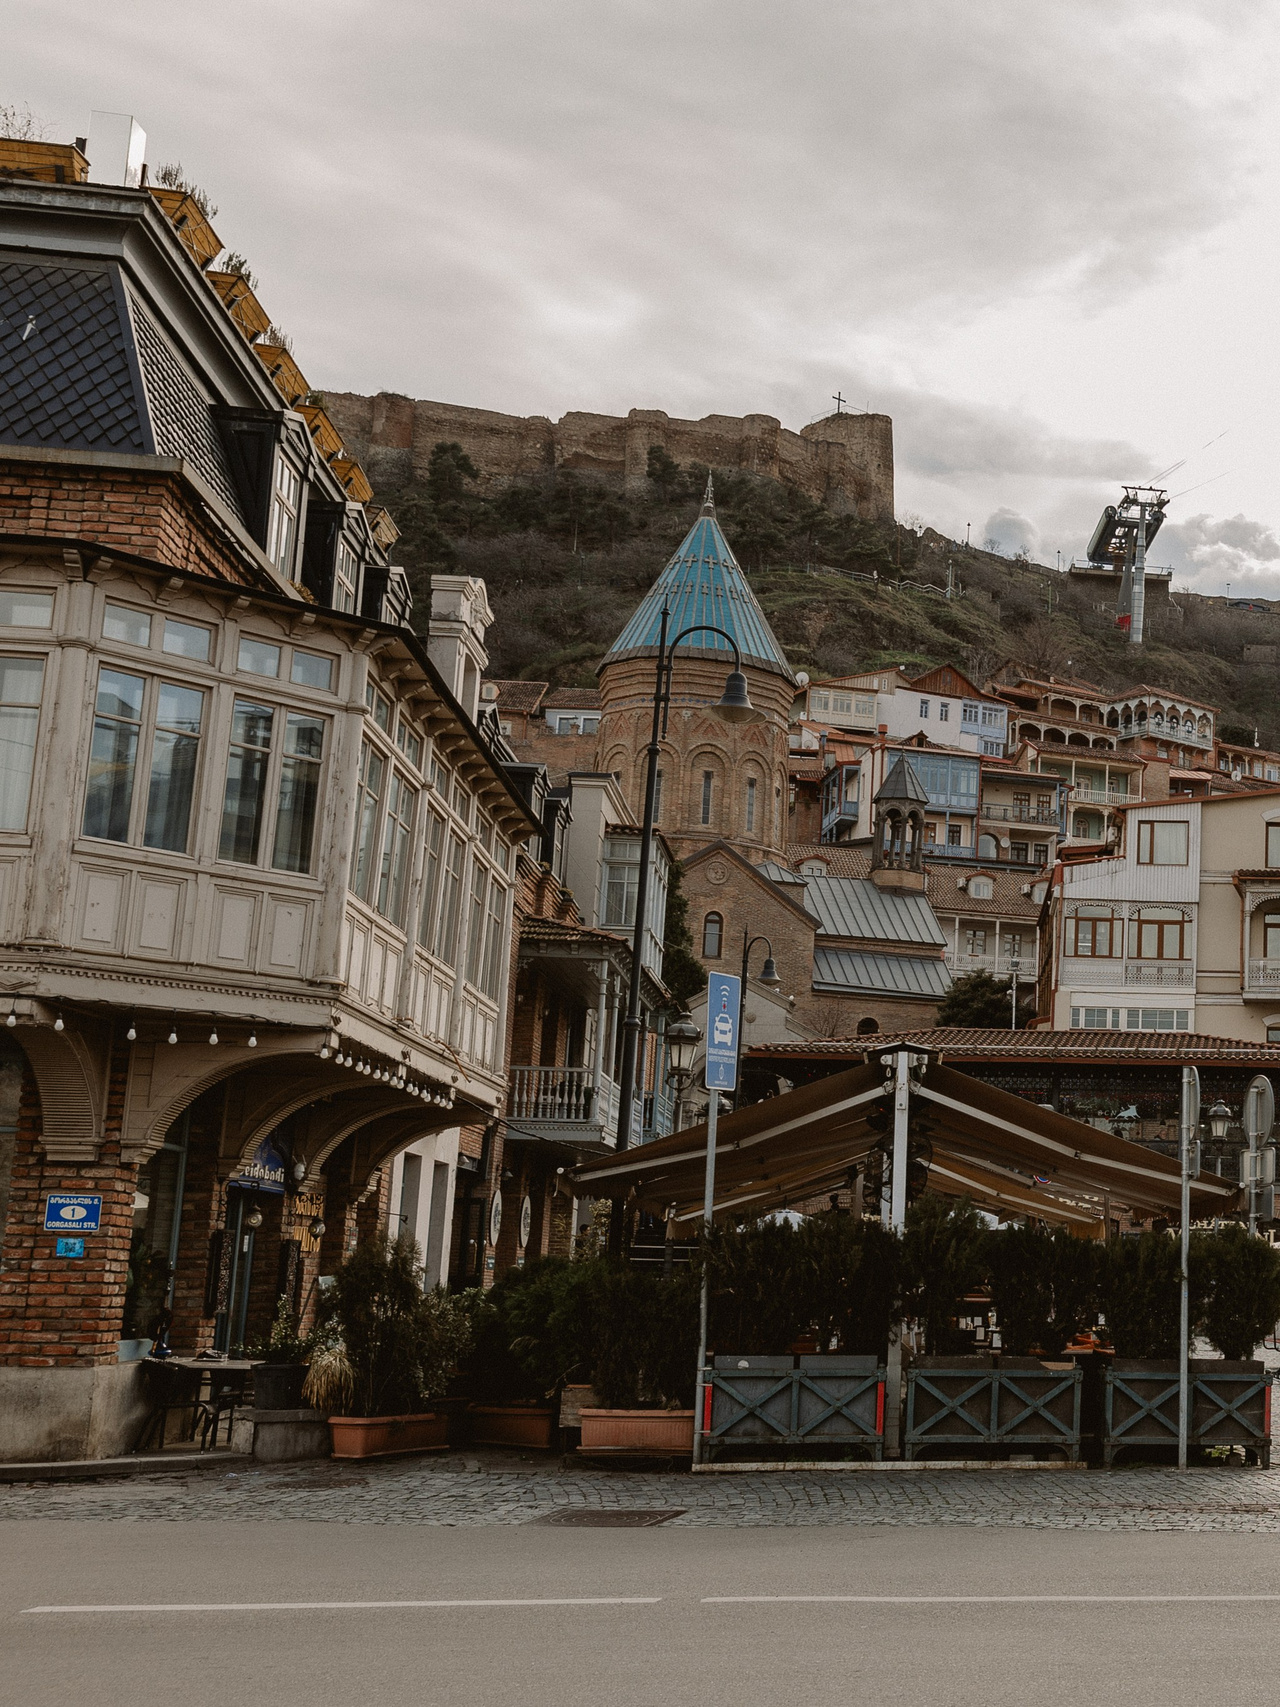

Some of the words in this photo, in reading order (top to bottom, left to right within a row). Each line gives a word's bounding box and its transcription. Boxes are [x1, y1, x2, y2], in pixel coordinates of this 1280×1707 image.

[240, 1163, 285, 1183] eidabadi
[71, 1207, 76, 1218] 1
[46, 1221, 82, 1229] GORGASALI
[83, 1221, 98, 1229] STR.
